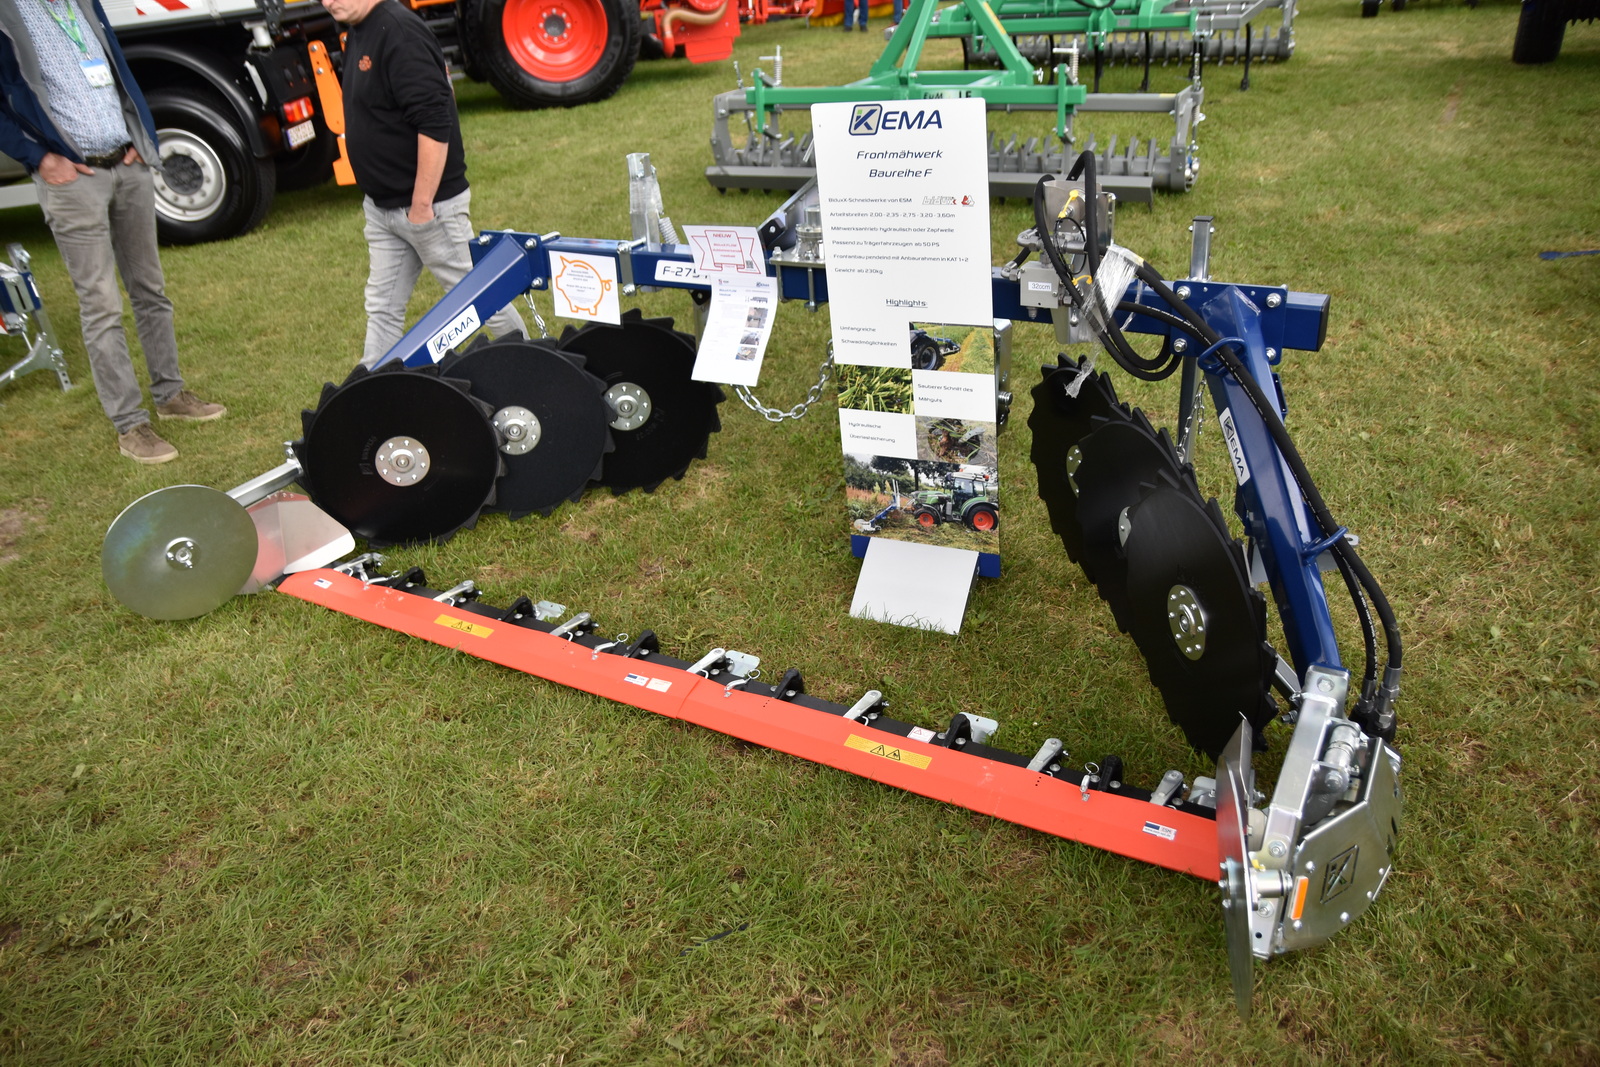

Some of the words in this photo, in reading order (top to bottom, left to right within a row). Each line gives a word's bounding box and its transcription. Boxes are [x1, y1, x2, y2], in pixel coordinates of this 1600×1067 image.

[848, 103, 943, 135] KEMA
[856, 149, 943, 160] Frontmähwerk
[869, 168, 923, 178] Baureihe
[924, 168, 933, 178] F
[433, 316, 475, 354] KEMA
[1223, 416, 1245, 477] KEMA
